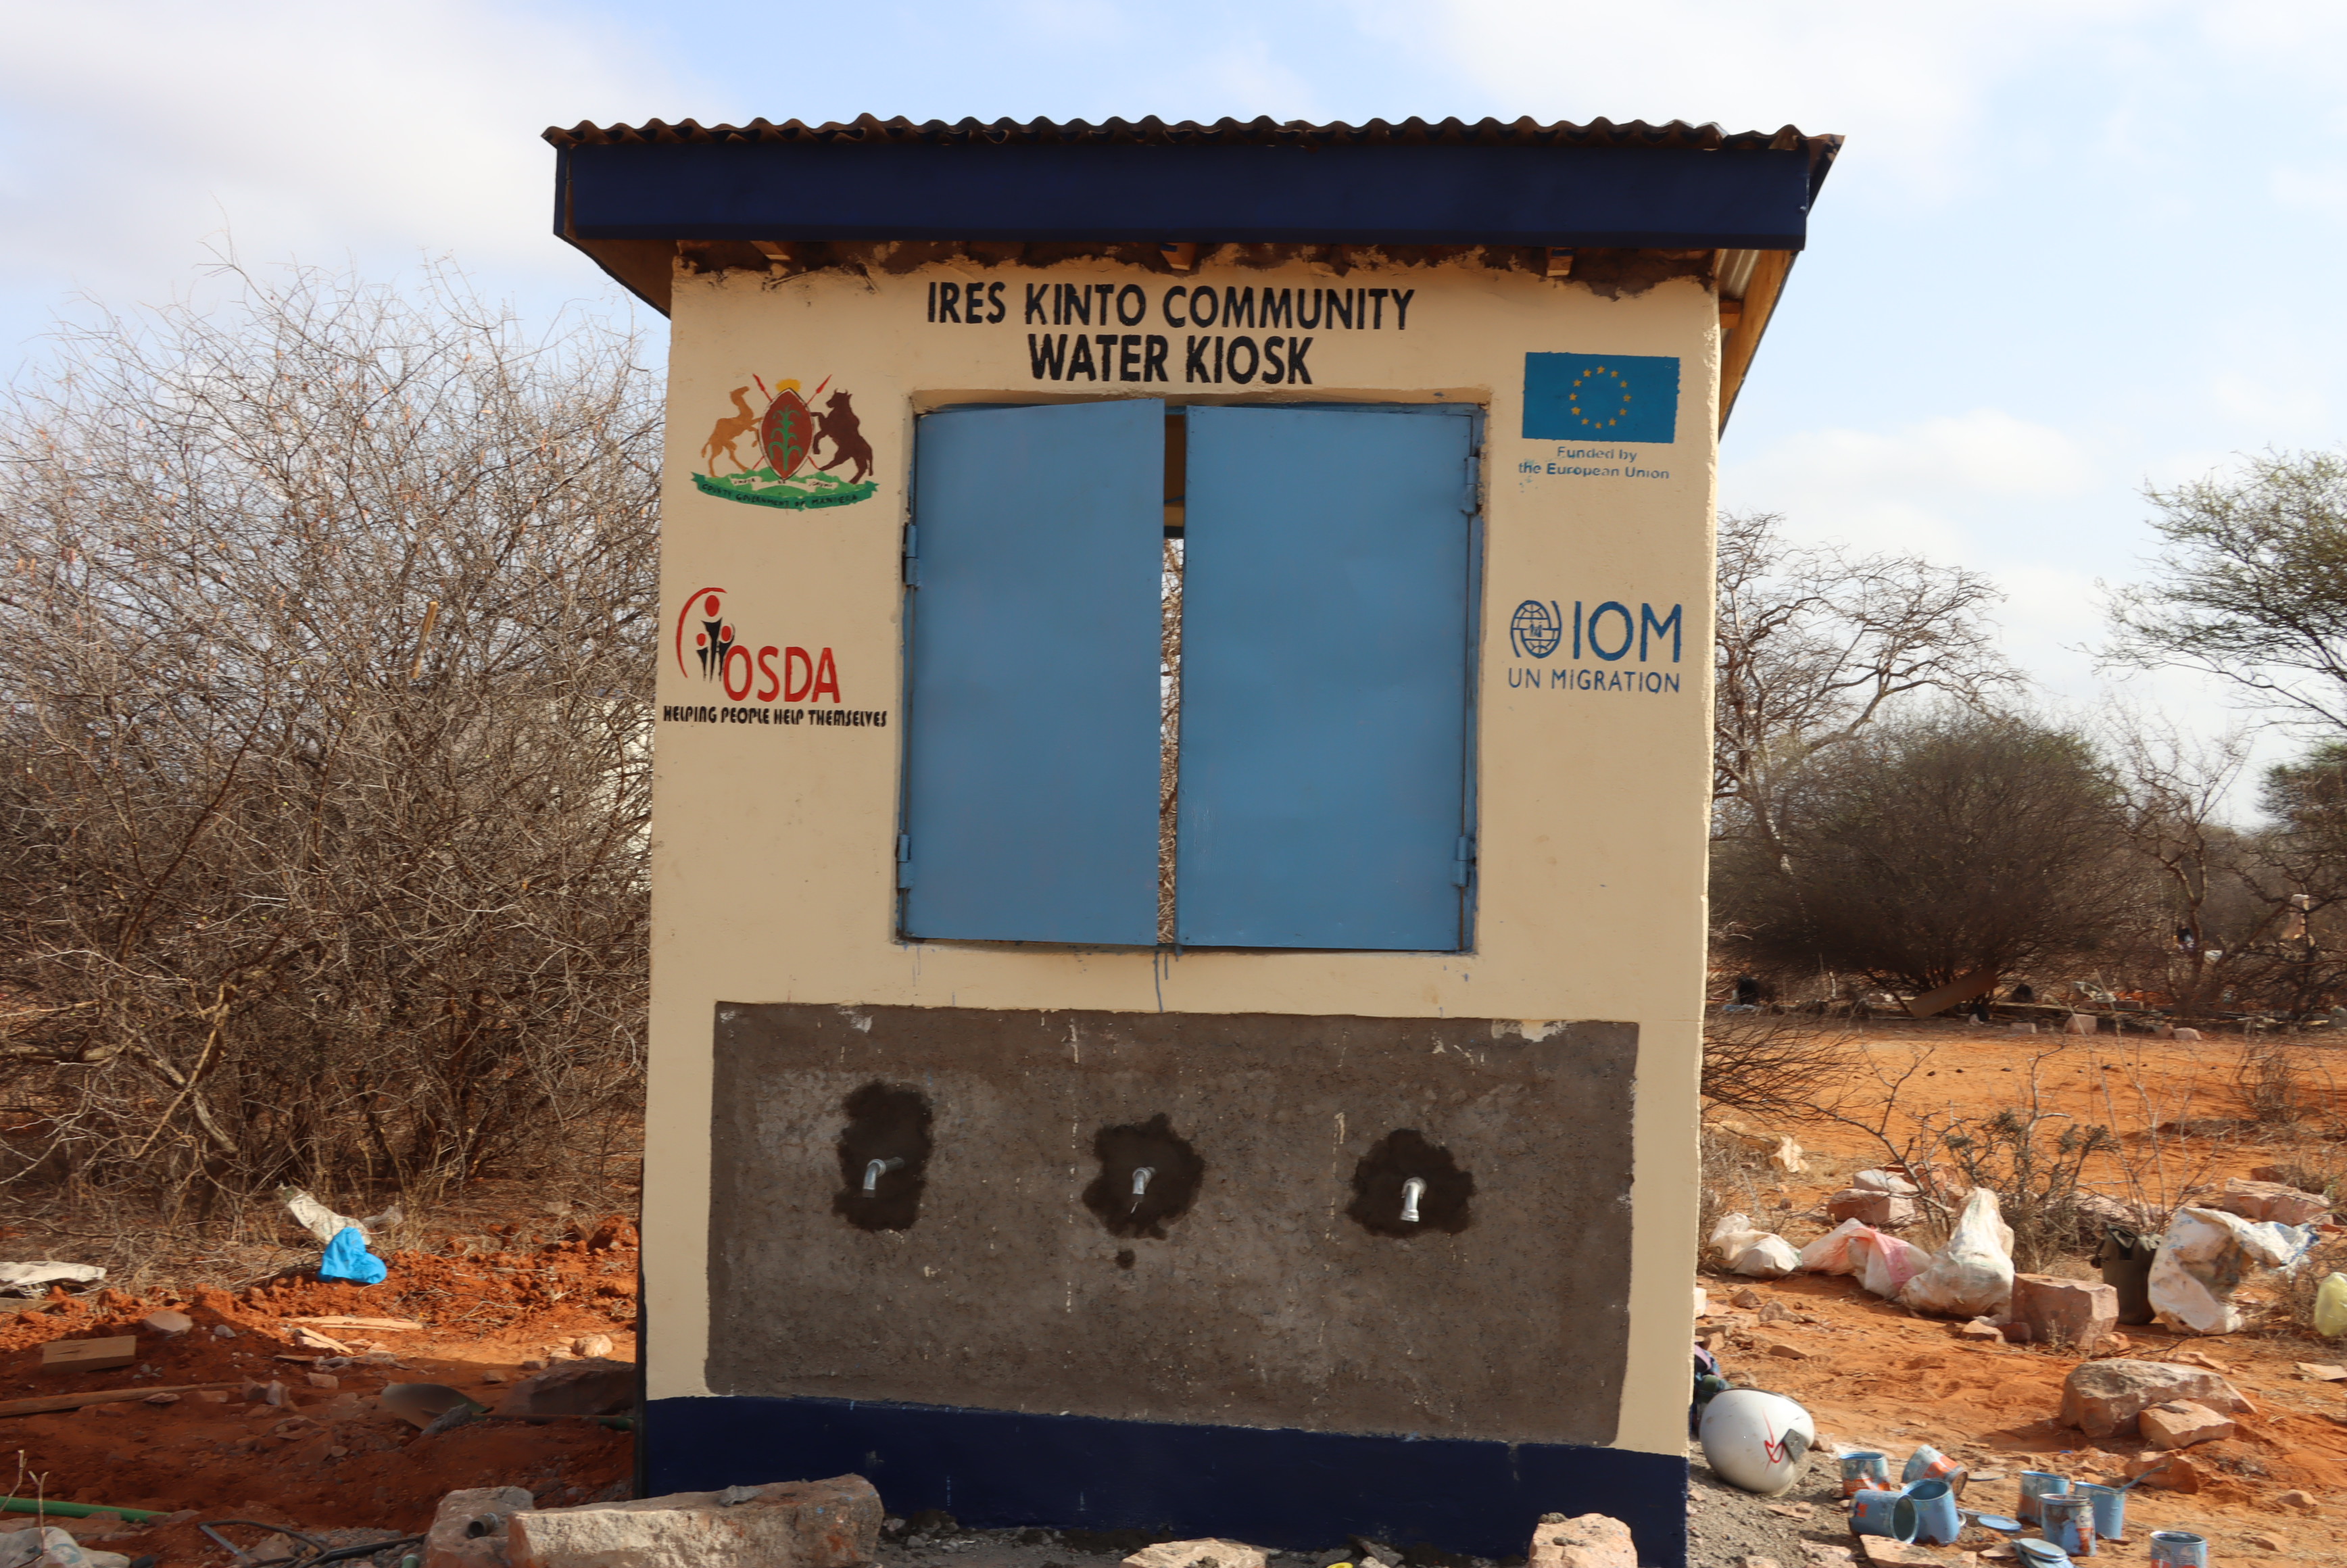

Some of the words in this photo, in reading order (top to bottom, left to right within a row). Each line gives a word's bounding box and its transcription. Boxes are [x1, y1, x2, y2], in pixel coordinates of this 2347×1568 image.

[927, 280, 1007, 324] IRES
[1024, 283, 1147, 327] KINTO
[1162, 285, 1416, 330] COMMUNITY
[1027, 333, 1169, 383] WATER
[1185, 335, 1314, 385] KIOSK
[1557, 446, 1614, 460] Funded
[1619, 449, 1637, 463] by
[1518, 462, 1542, 474] the
[1546, 462, 1620, 477] European
[1624, 466, 1670, 479] Union
[1572, 600, 1683, 663] IOM
[1508, 667, 1541, 689] UN
[1551, 668, 1680, 694] MIGRATION
[663, 705, 717, 724] HELPING
[721, 706, 770, 725] PEOPLE
[773, 708, 804, 725] HELP
[807, 709, 888, 728] THEMSELVES
